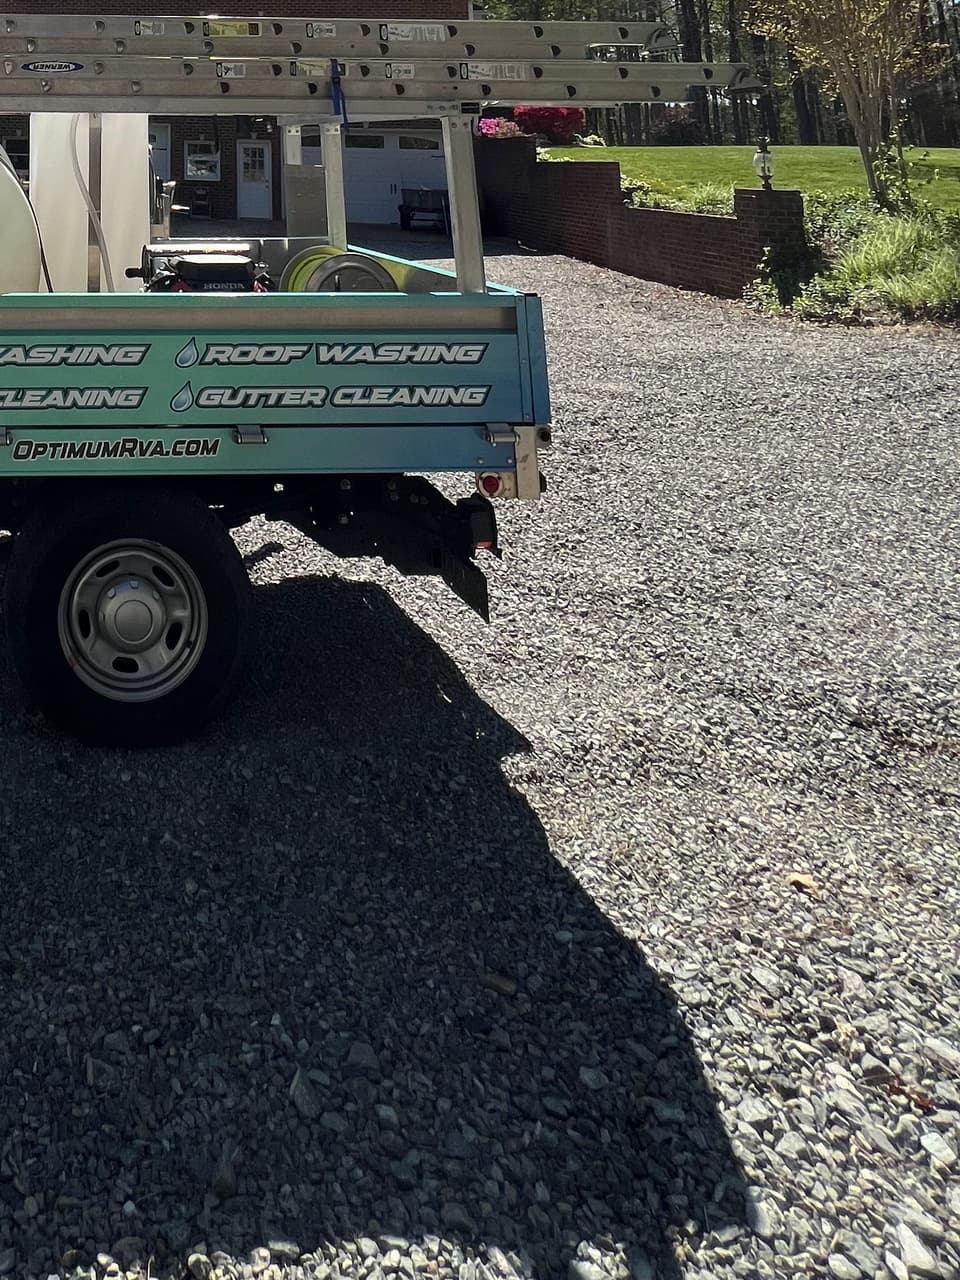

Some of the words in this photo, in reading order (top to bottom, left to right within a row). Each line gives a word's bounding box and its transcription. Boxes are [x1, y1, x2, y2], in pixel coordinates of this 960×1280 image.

[32, 63, 73, 71] WERNER
[201, 344, 311, 364] ROOF
[317, 343, 486, 363] WASHING
[198, 388, 329, 407] GUTTER
[332, 387, 489, 406] CLEANING
